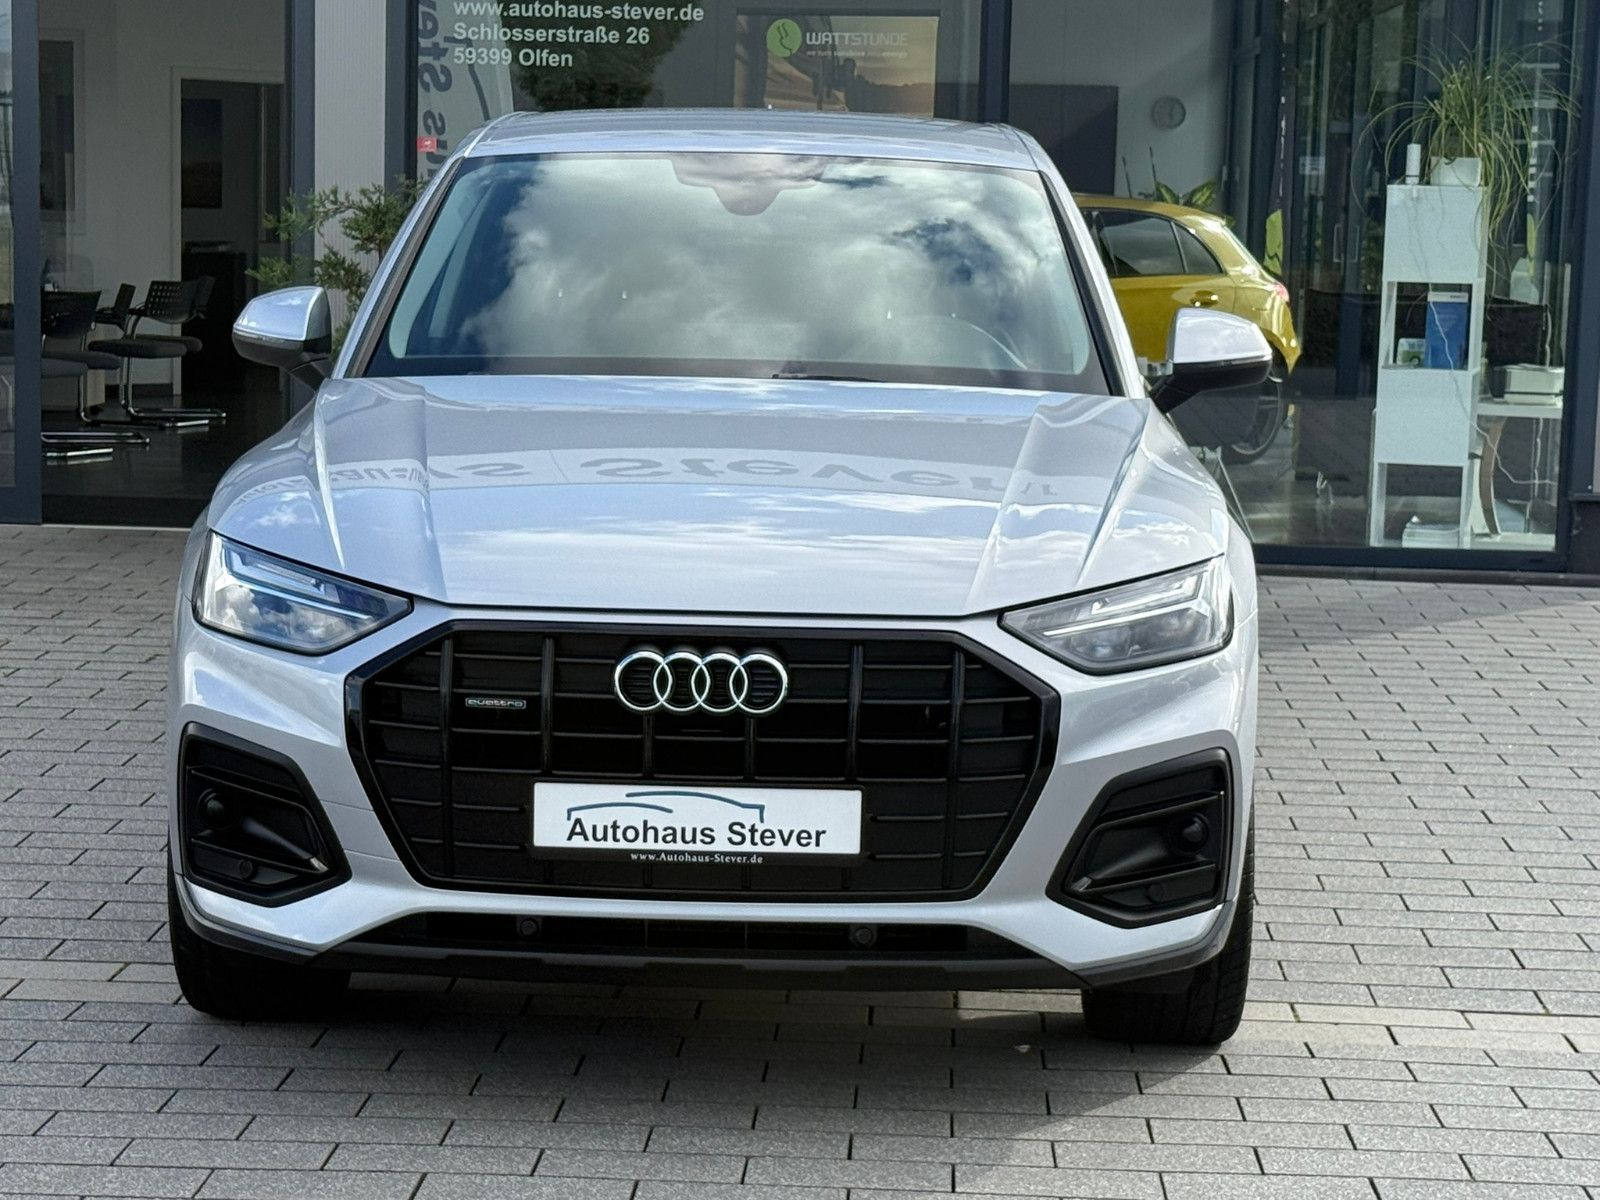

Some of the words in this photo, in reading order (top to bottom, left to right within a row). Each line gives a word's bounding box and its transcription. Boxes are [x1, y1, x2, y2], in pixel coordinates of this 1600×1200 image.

[453, 0, 705, 21] www.autohaus-stever.de
[453, 22, 621, 44] Schlosserstraße
[626, 26, 650, 45] 26
[806, 32, 908, 46] WATTSTUNDE
[453, 48, 512, 66] 59399
[518, 48, 573, 67] Olfen
[466, 698, 524, 708] quattro
[566, 817, 716, 846] Autohaus
[727, 821, 827, 847] Stever
[629, 851, 764, 864] www.Autohaus-Stever.de
